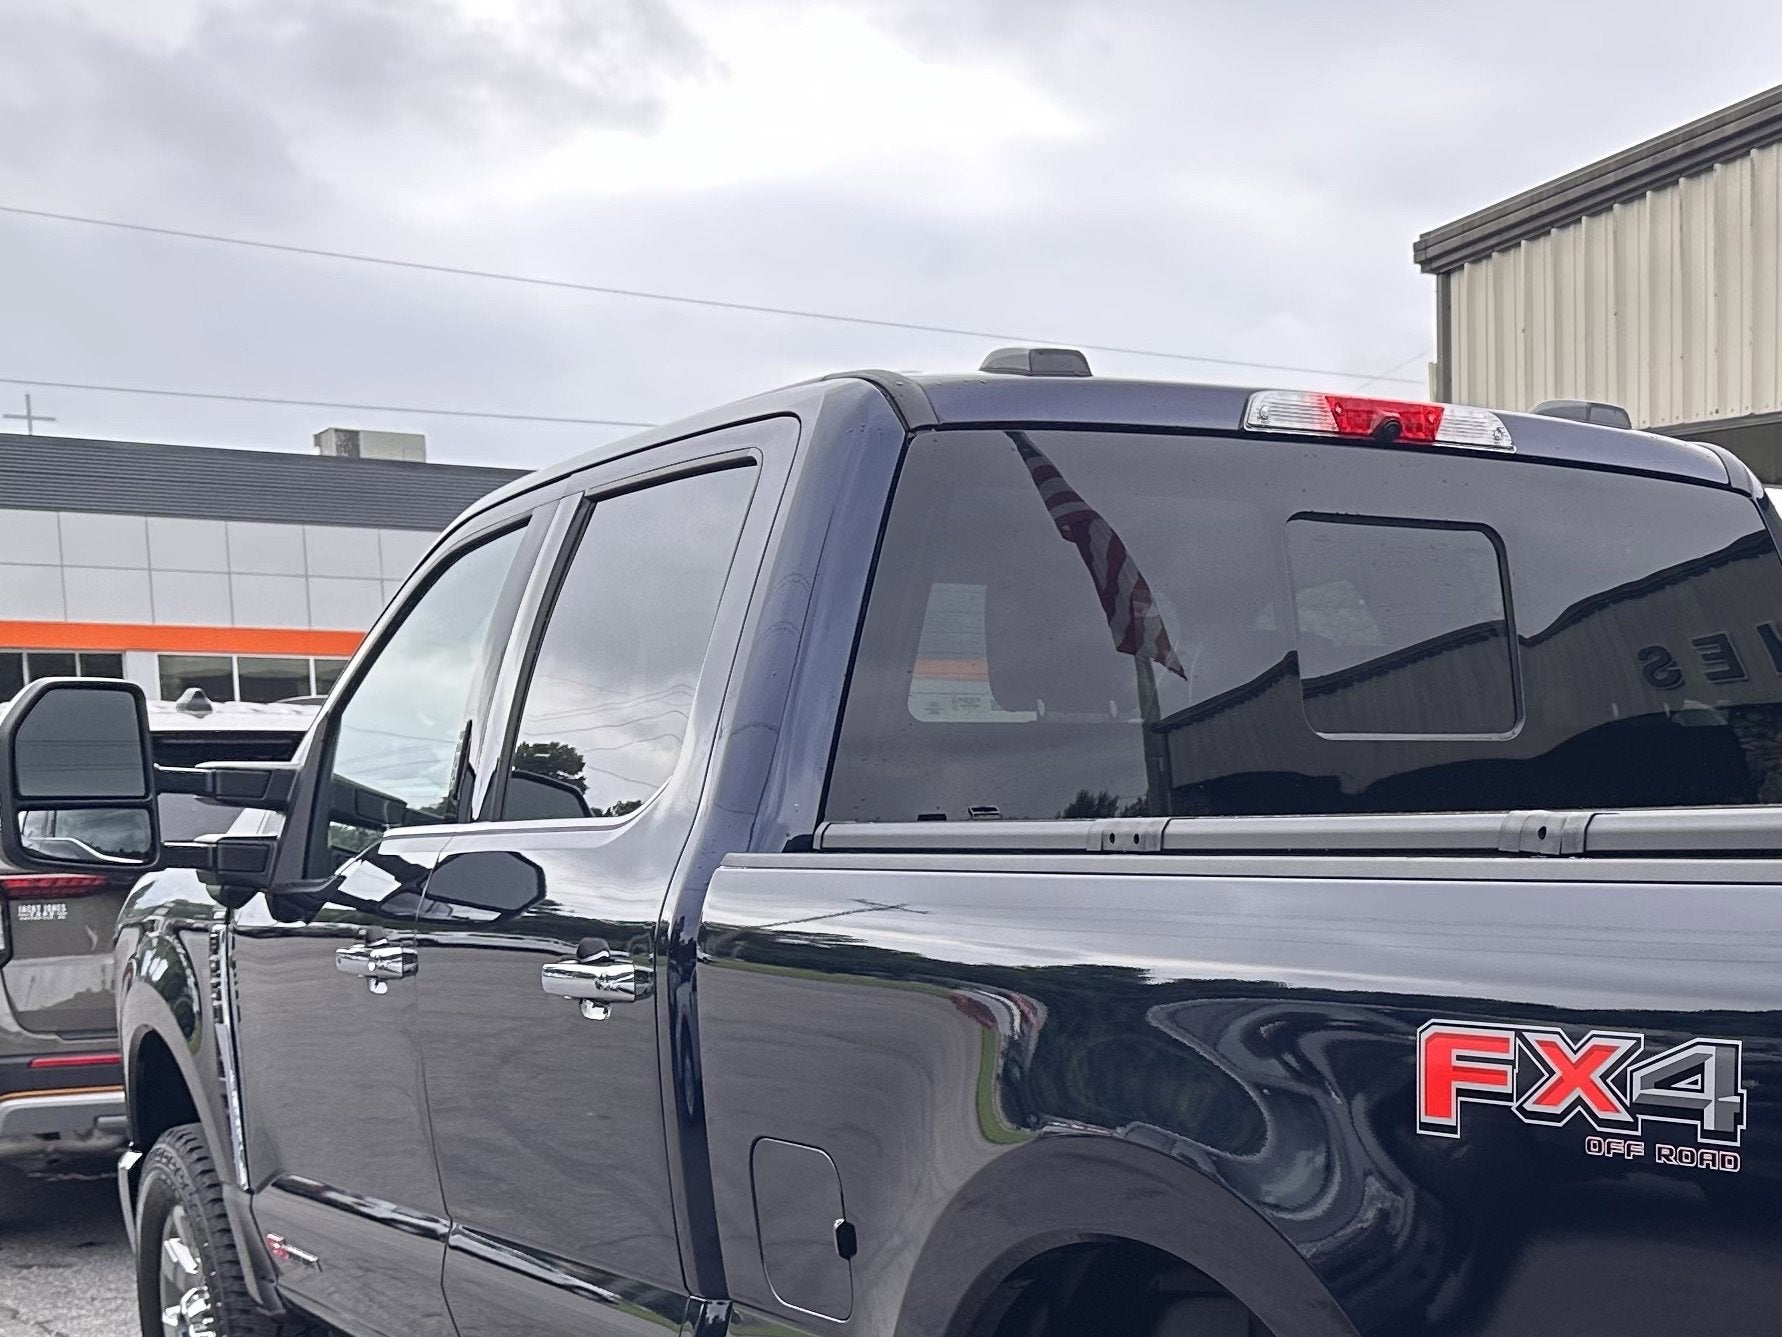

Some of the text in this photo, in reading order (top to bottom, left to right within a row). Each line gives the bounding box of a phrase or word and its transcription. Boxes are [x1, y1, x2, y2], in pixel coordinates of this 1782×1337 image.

[1416, 1018, 1747, 1147] FX4
[1584, 1135, 1742, 1173] OFF ROAD
